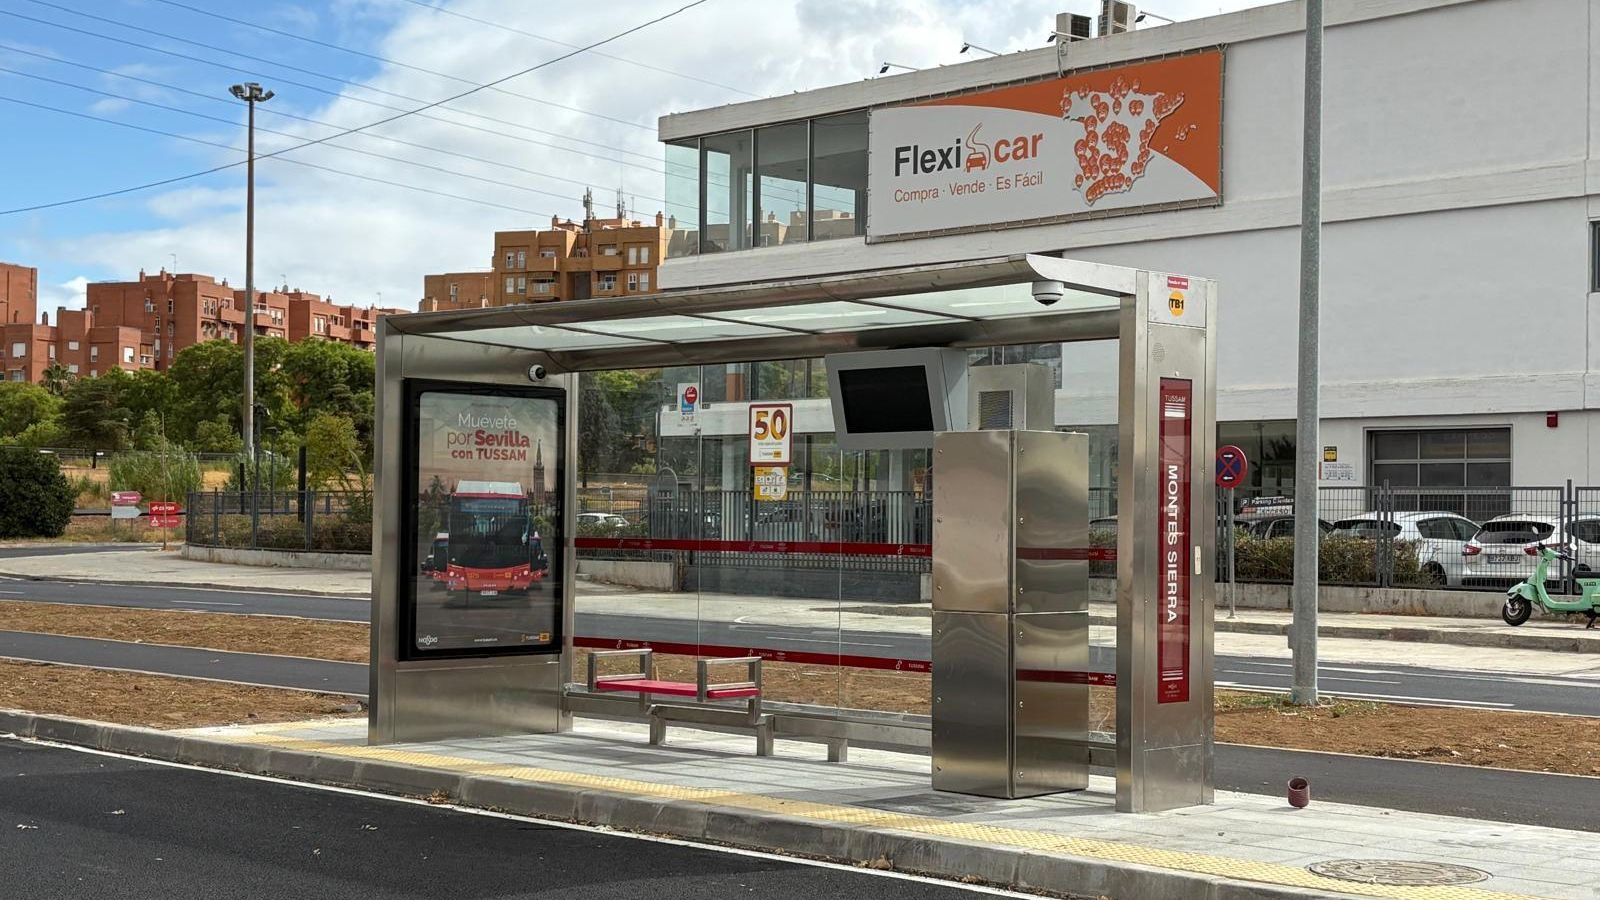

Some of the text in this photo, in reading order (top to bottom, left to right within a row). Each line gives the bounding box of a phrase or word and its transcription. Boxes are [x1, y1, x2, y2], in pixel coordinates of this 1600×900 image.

[894, 131, 1044, 177] Flexi car
[894, 171, 1044, 203] Compra Vende Es Fácil
[458, 412, 518, 430] Muévete
[753, 409, 788, 441] 50
[447, 429, 531, 449] por Sevilla
[451, 449, 527, 461] con TUSSAM
[1167, 464, 1179, 623] MONTES SIERRA
